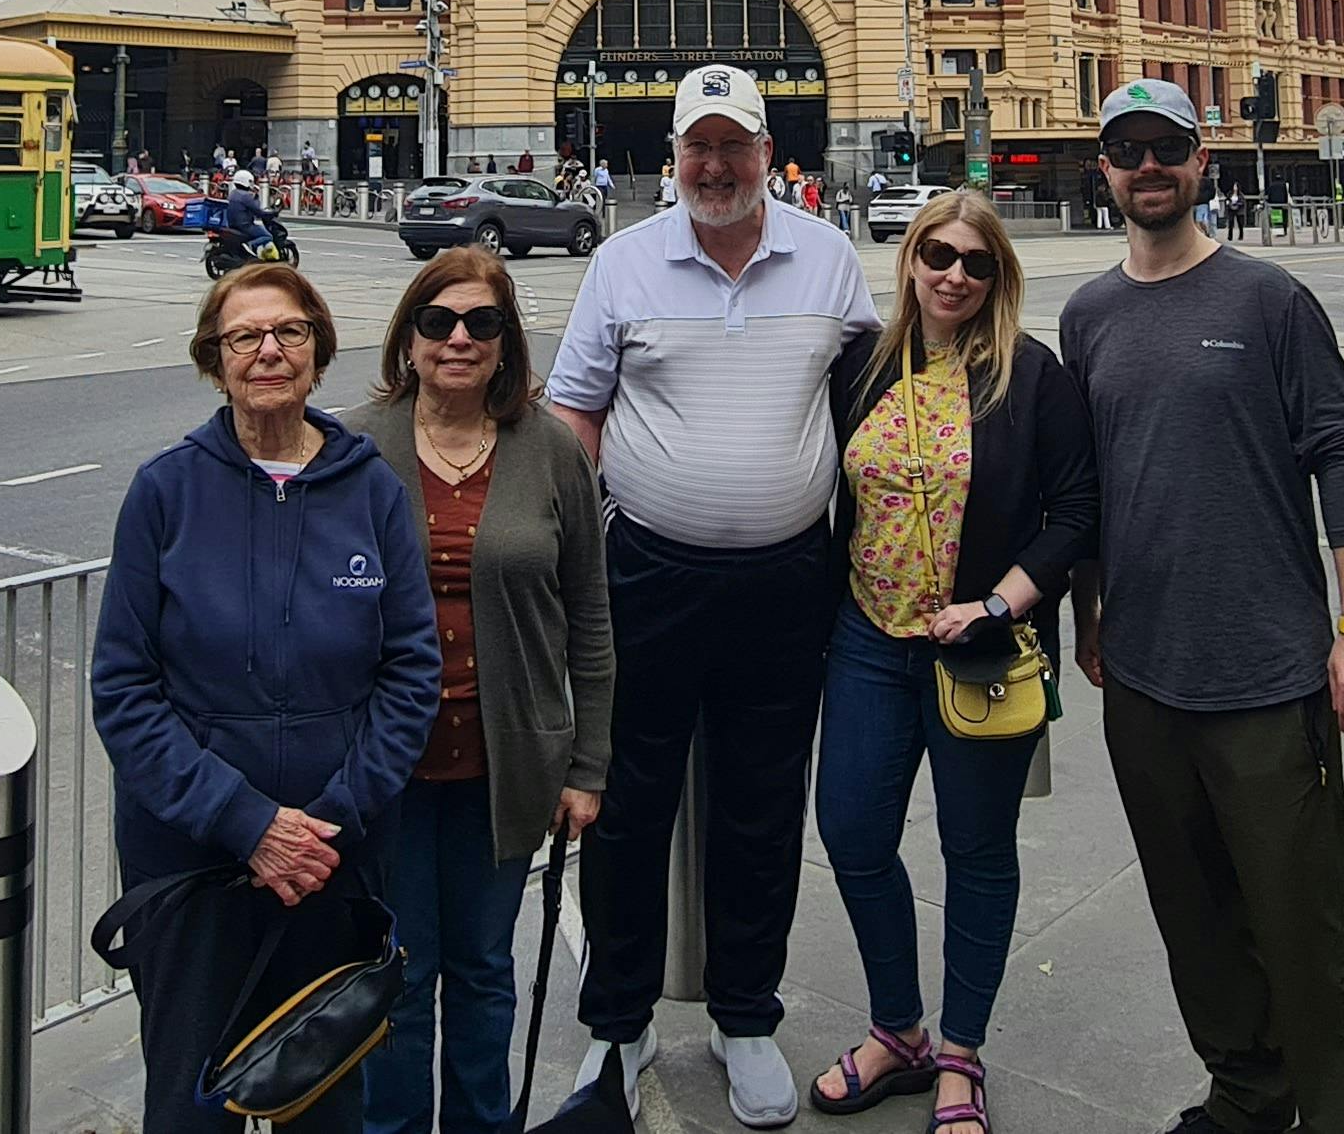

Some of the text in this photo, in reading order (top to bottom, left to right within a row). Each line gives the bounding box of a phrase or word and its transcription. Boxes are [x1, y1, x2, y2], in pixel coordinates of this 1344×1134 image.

[599, 50, 784, 62] FLINDERS STREET STATION
[1209, 339, 1245, 349] Columbia
[332, 576, 384, 588] NOORDAM
